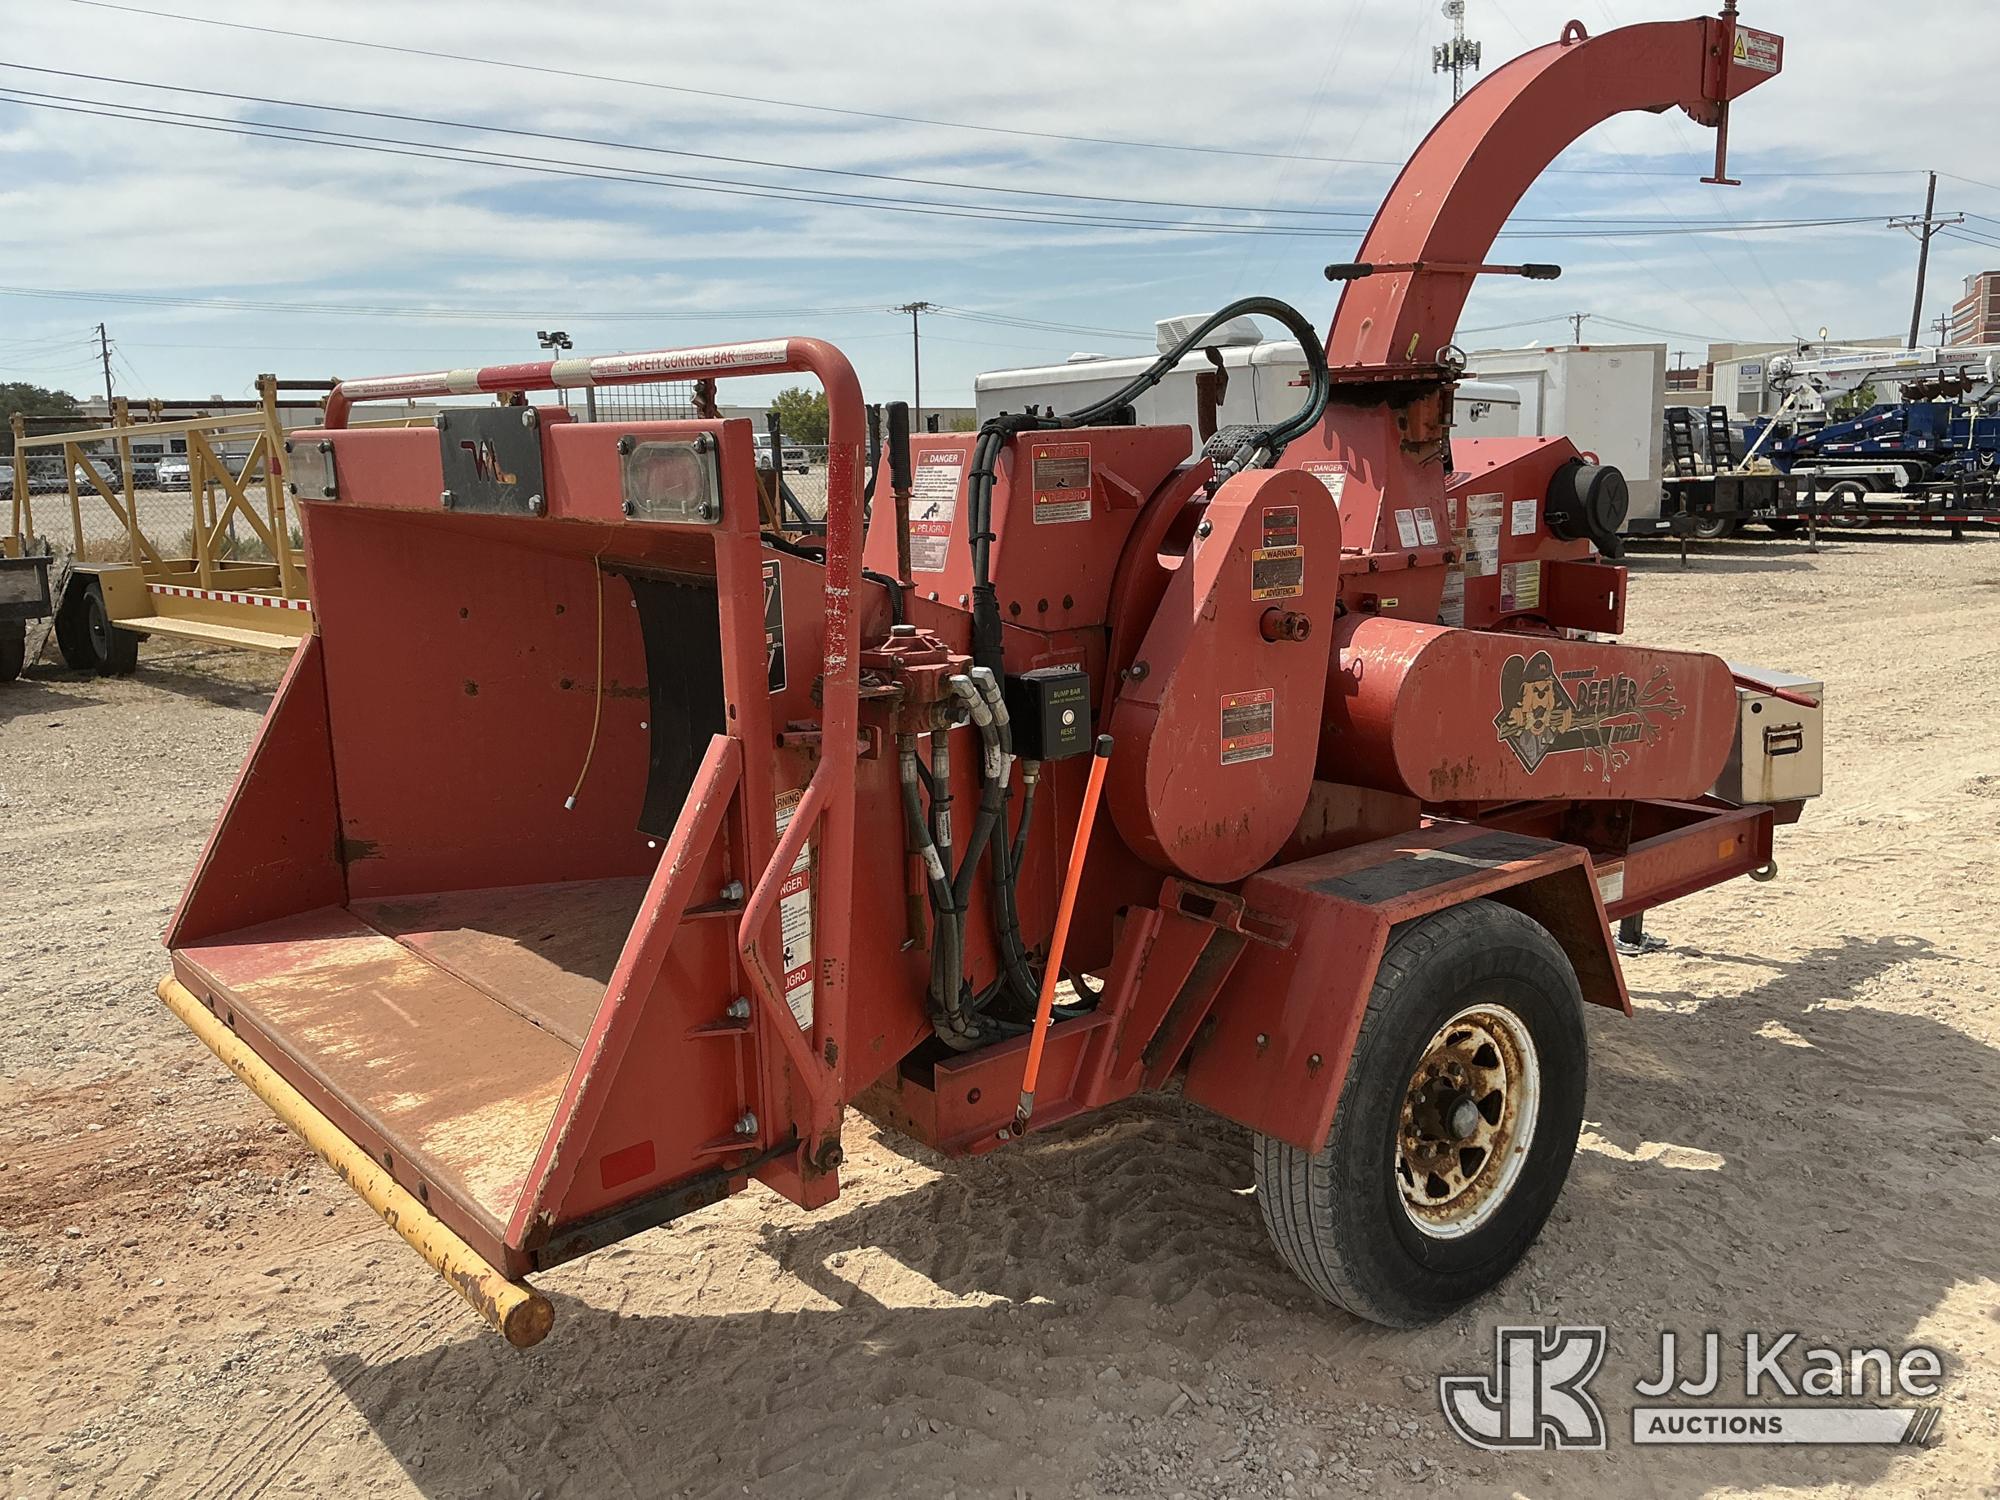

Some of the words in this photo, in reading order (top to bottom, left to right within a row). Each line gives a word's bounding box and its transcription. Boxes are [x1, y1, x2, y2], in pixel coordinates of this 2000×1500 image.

[628, 357, 661, 371] SAFETY
[664, 353, 711, 369] CONTROL
[713, 351, 736, 364] BAR
[929, 454, 959, 464] DANGER
[1313, 464, 1343, 472] DANGER
[917, 524, 946, 534] PELIGRO
[1266, 549, 1297, 559] WARNING
[1577, 674, 1637, 713] BEEVER
[1060, 727, 1076, 736] RESET
[777, 792, 800, 808] RNING
[780, 877, 803, 895] NGER
[786, 969, 807, 989] IGRO
